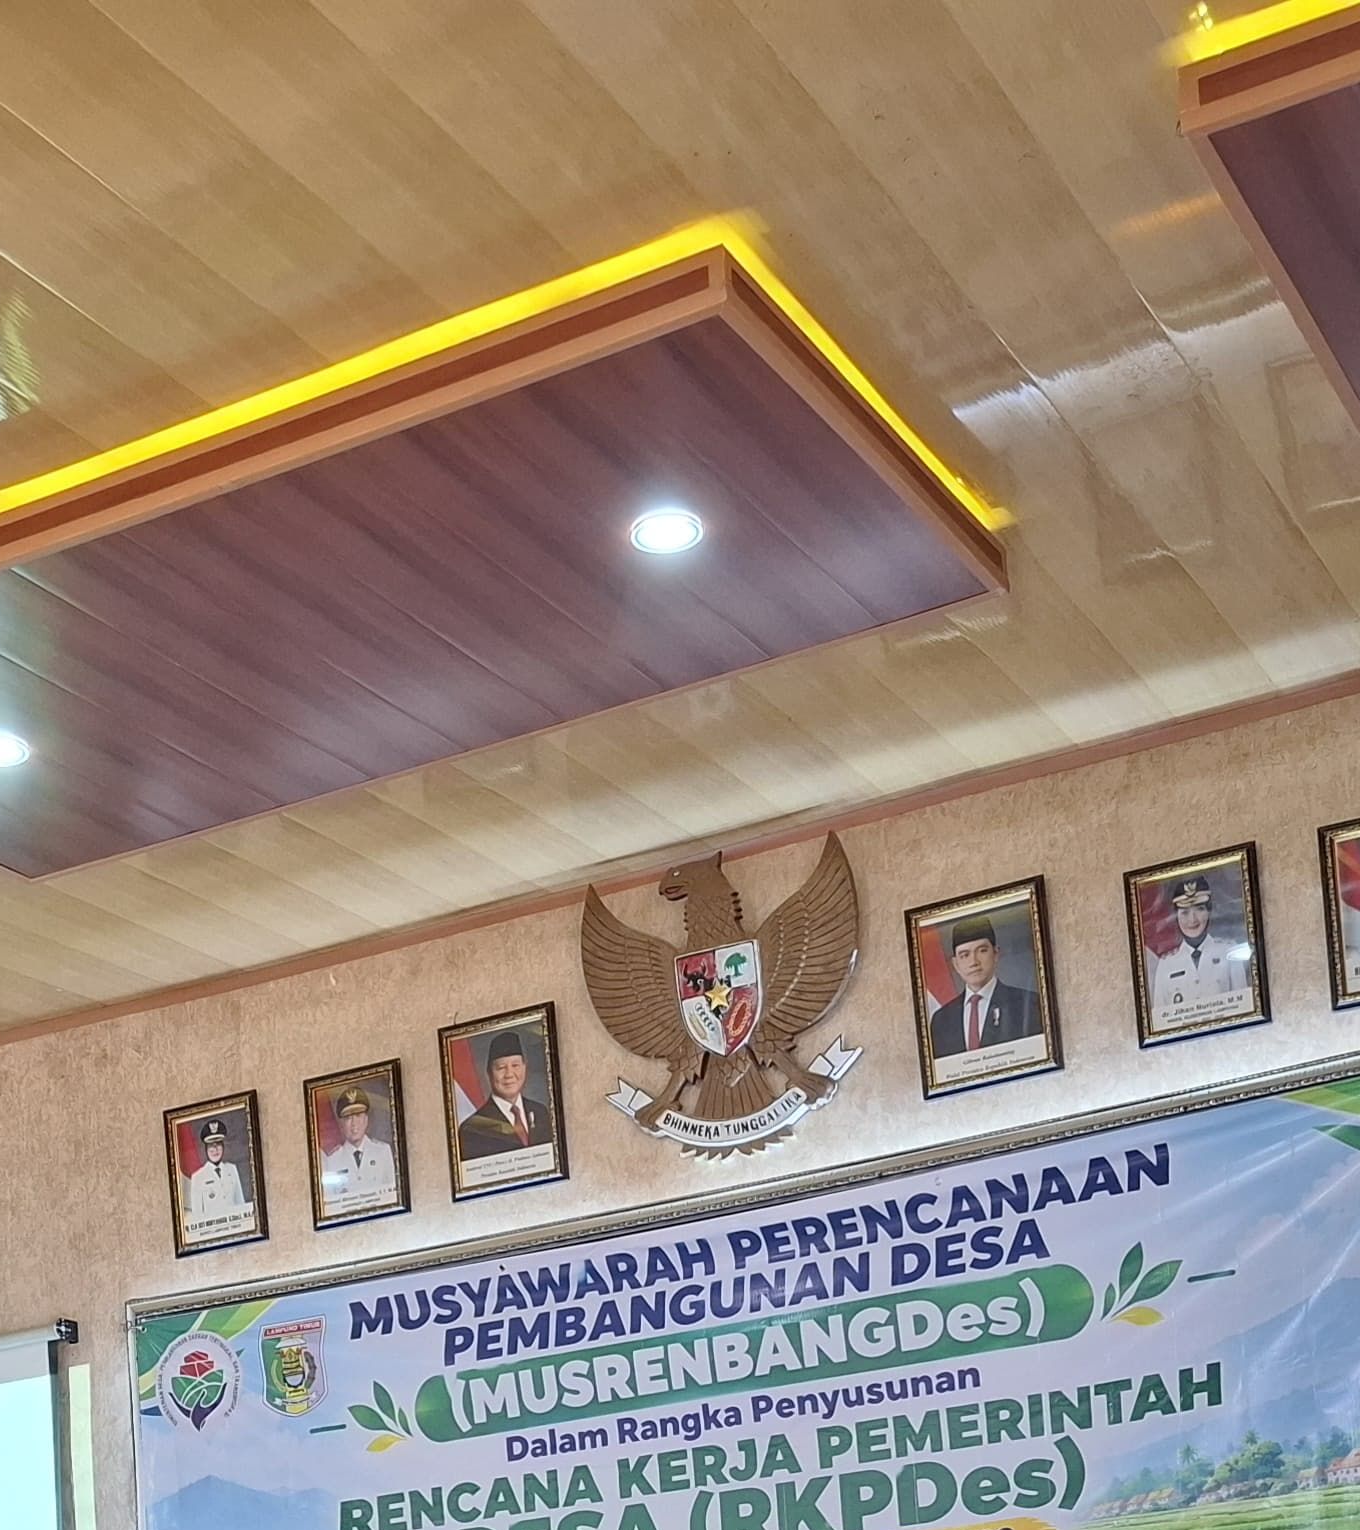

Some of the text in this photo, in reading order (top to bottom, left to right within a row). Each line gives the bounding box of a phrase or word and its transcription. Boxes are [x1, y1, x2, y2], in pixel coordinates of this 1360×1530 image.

[663, 1112, 720, 1140] BHINNEKA
[725, 1110, 780, 1136] TUNGGAL
[349, 1143, 1171, 1340] MUSYAWARAH PERENCANAAN
[443, 1219, 1050, 1366] PEMBANGUNAN DESA
[449, 1278, 1047, 1432] (MUSRENBANGDes)
[507, 1365, 981, 1462] Dalam Rangka Penyusunan
[618, 1436, 803, 1500] KERJA
[818, 1362, 1223, 1470] PEMERINTAH
